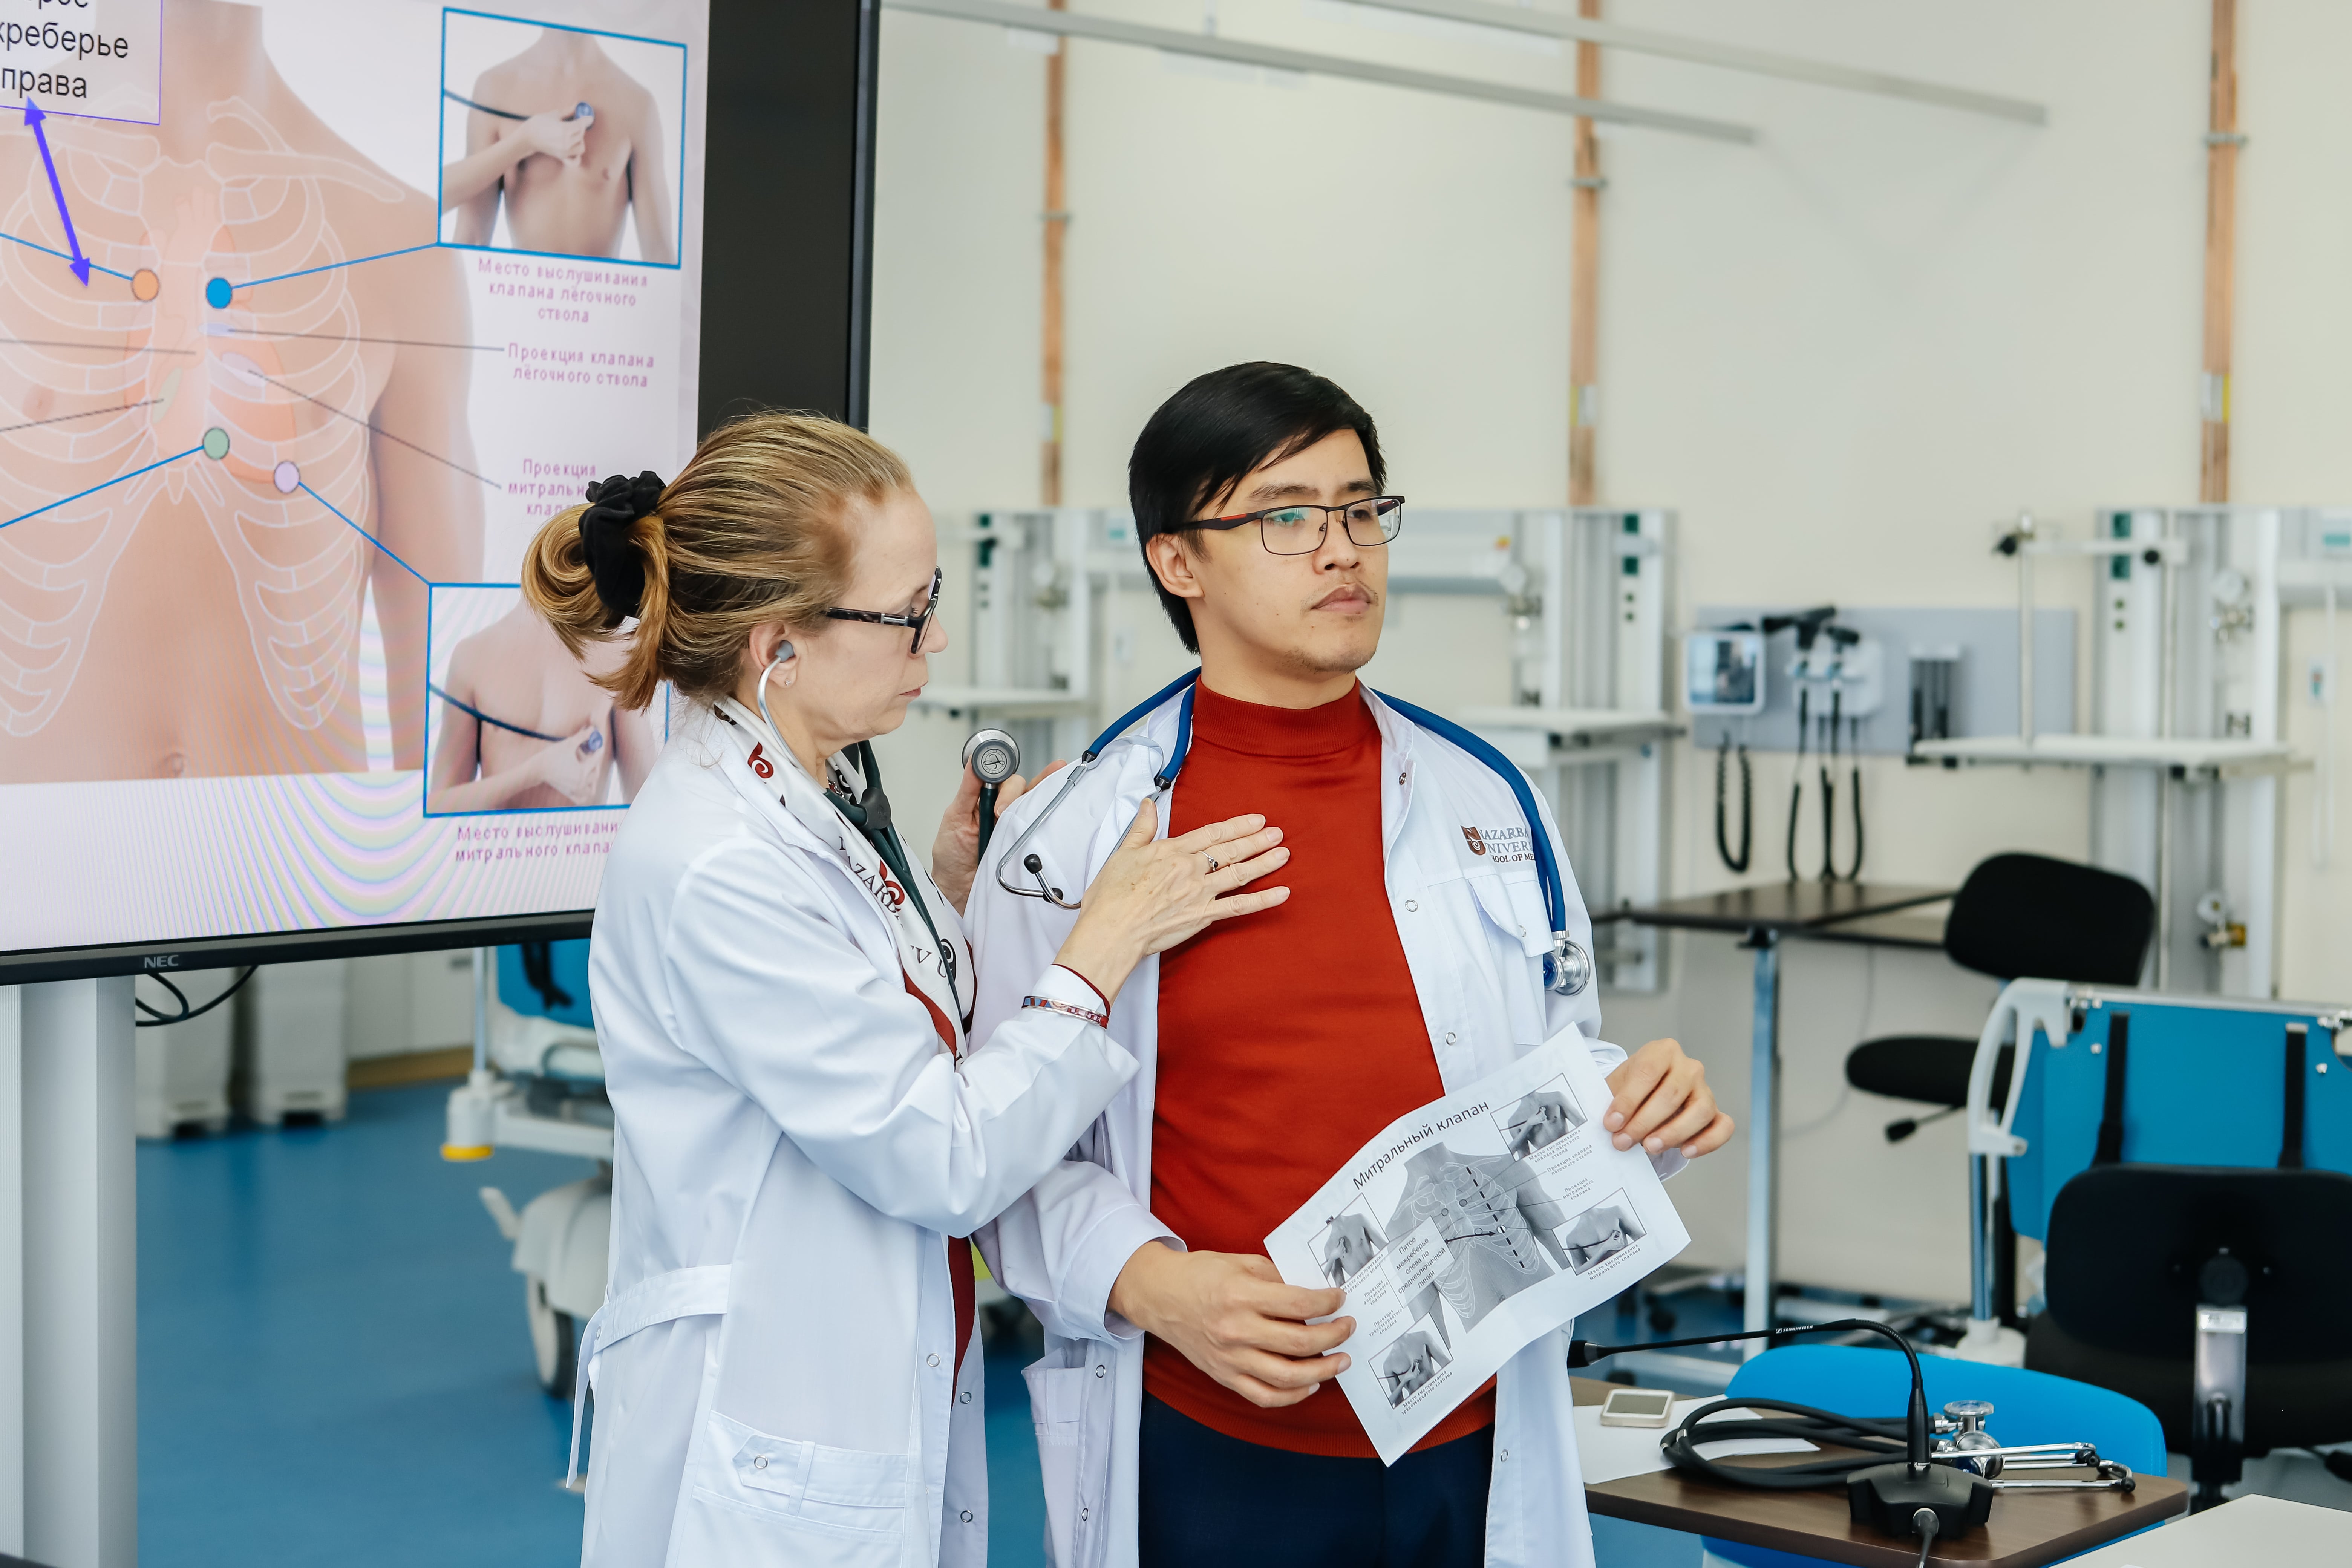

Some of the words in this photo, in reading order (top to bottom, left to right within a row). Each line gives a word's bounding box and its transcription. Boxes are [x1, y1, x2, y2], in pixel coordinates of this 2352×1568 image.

[0, 22, 129, 60] реберье
[479, 257, 529, 277] Место
[537, 265, 648, 287] выслушивания
[490, 283, 554, 300] клапана
[538, 308, 589, 323] ствола
[508, 342, 583, 365] Проекция
[591, 352, 654, 368] клапана
[597, 373, 648, 388] ствола
[523, 459, 596, 479] Проекция
[508, 483, 585, 499] митральн
[527, 504, 572, 516] клап
[458, 826, 508, 841] Место
[516, 821, 618, 839] выслушивани
[455, 845, 558, 864] митрального
[565, 841, 611, 856] клапа
[144, 954, 179, 968] NEC
[1353, 1124, 1434, 1190] Митральный
[1436, 1102, 1489, 1131] клапан
[1396, 1238, 1429, 1270] межреберье
[1398, 1237, 1416, 1254] Пятое
[1398, 1247, 1446, 1294] среднеключичной
[1405, 1257, 1422, 1274] слева
[1421, 1251, 1429, 1260] по
[1418, 1271, 1435, 1288] линии
